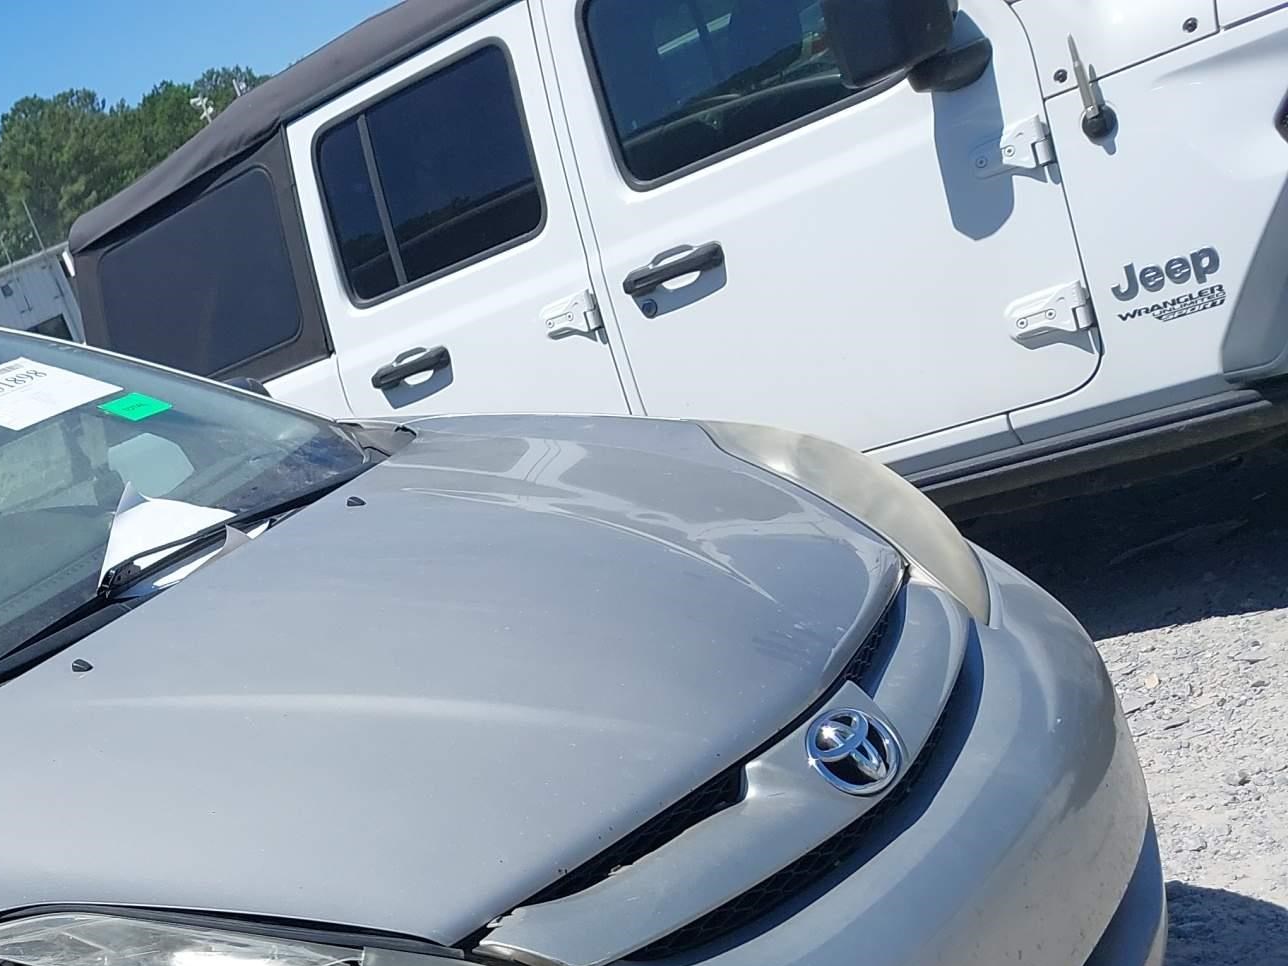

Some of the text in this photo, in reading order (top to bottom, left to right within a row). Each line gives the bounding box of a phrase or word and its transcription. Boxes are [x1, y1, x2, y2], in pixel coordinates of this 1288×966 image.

[1111, 246, 1220, 302] Jeep
[1117, 284, 1225, 322] WRANGLER
[1152, 291, 1226, 317] UNLIMITED
